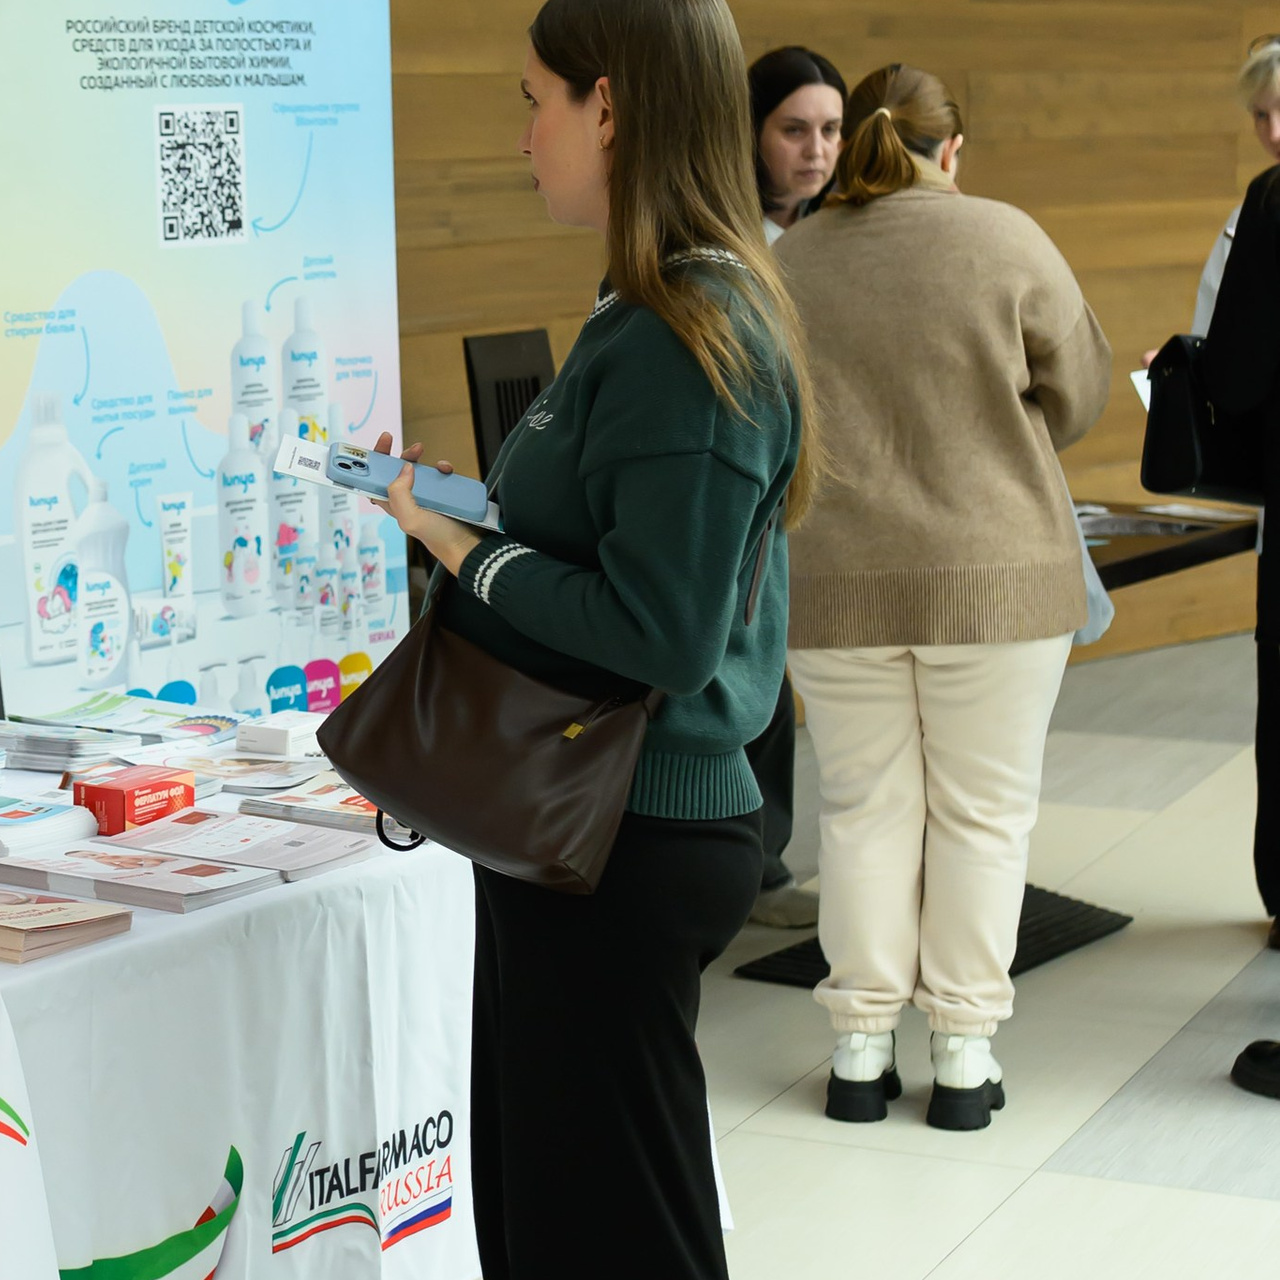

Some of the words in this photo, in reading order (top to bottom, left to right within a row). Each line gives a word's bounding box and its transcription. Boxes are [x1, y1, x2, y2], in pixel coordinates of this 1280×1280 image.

[66, 17, 150, 35] РОССИЙСКИЙ
[153, 20, 191, 35] БРЕНД
[193, 17, 245, 35] ДЕТСКОЙ
[72, 38, 126, 53] СРЕДСТВ
[128, 38, 153, 53] ДЛЯ
[155, 38, 196, 53] УХОДА
[199, 38, 214, 51] ЗА
[216, 38, 282, 51] ПОЛОСТЬЮ
[302, 38, 312, 51] И
[97, 53, 187, 71] ЭКОЛОГИЧНОЙ
[190, 53, 246, 70] БЫТОВОЙ
[80, 71, 158, 90] СОЗДАННЫЙ
[160, 75, 168, 88] С
[170, 74, 232, 88] ЛЮБОВЬЮ
[234, 74, 242, 87] К
[309, 1110, 454, 1211] ITALFARMACO
[380, 1155, 453, 1217] RUSSIA
